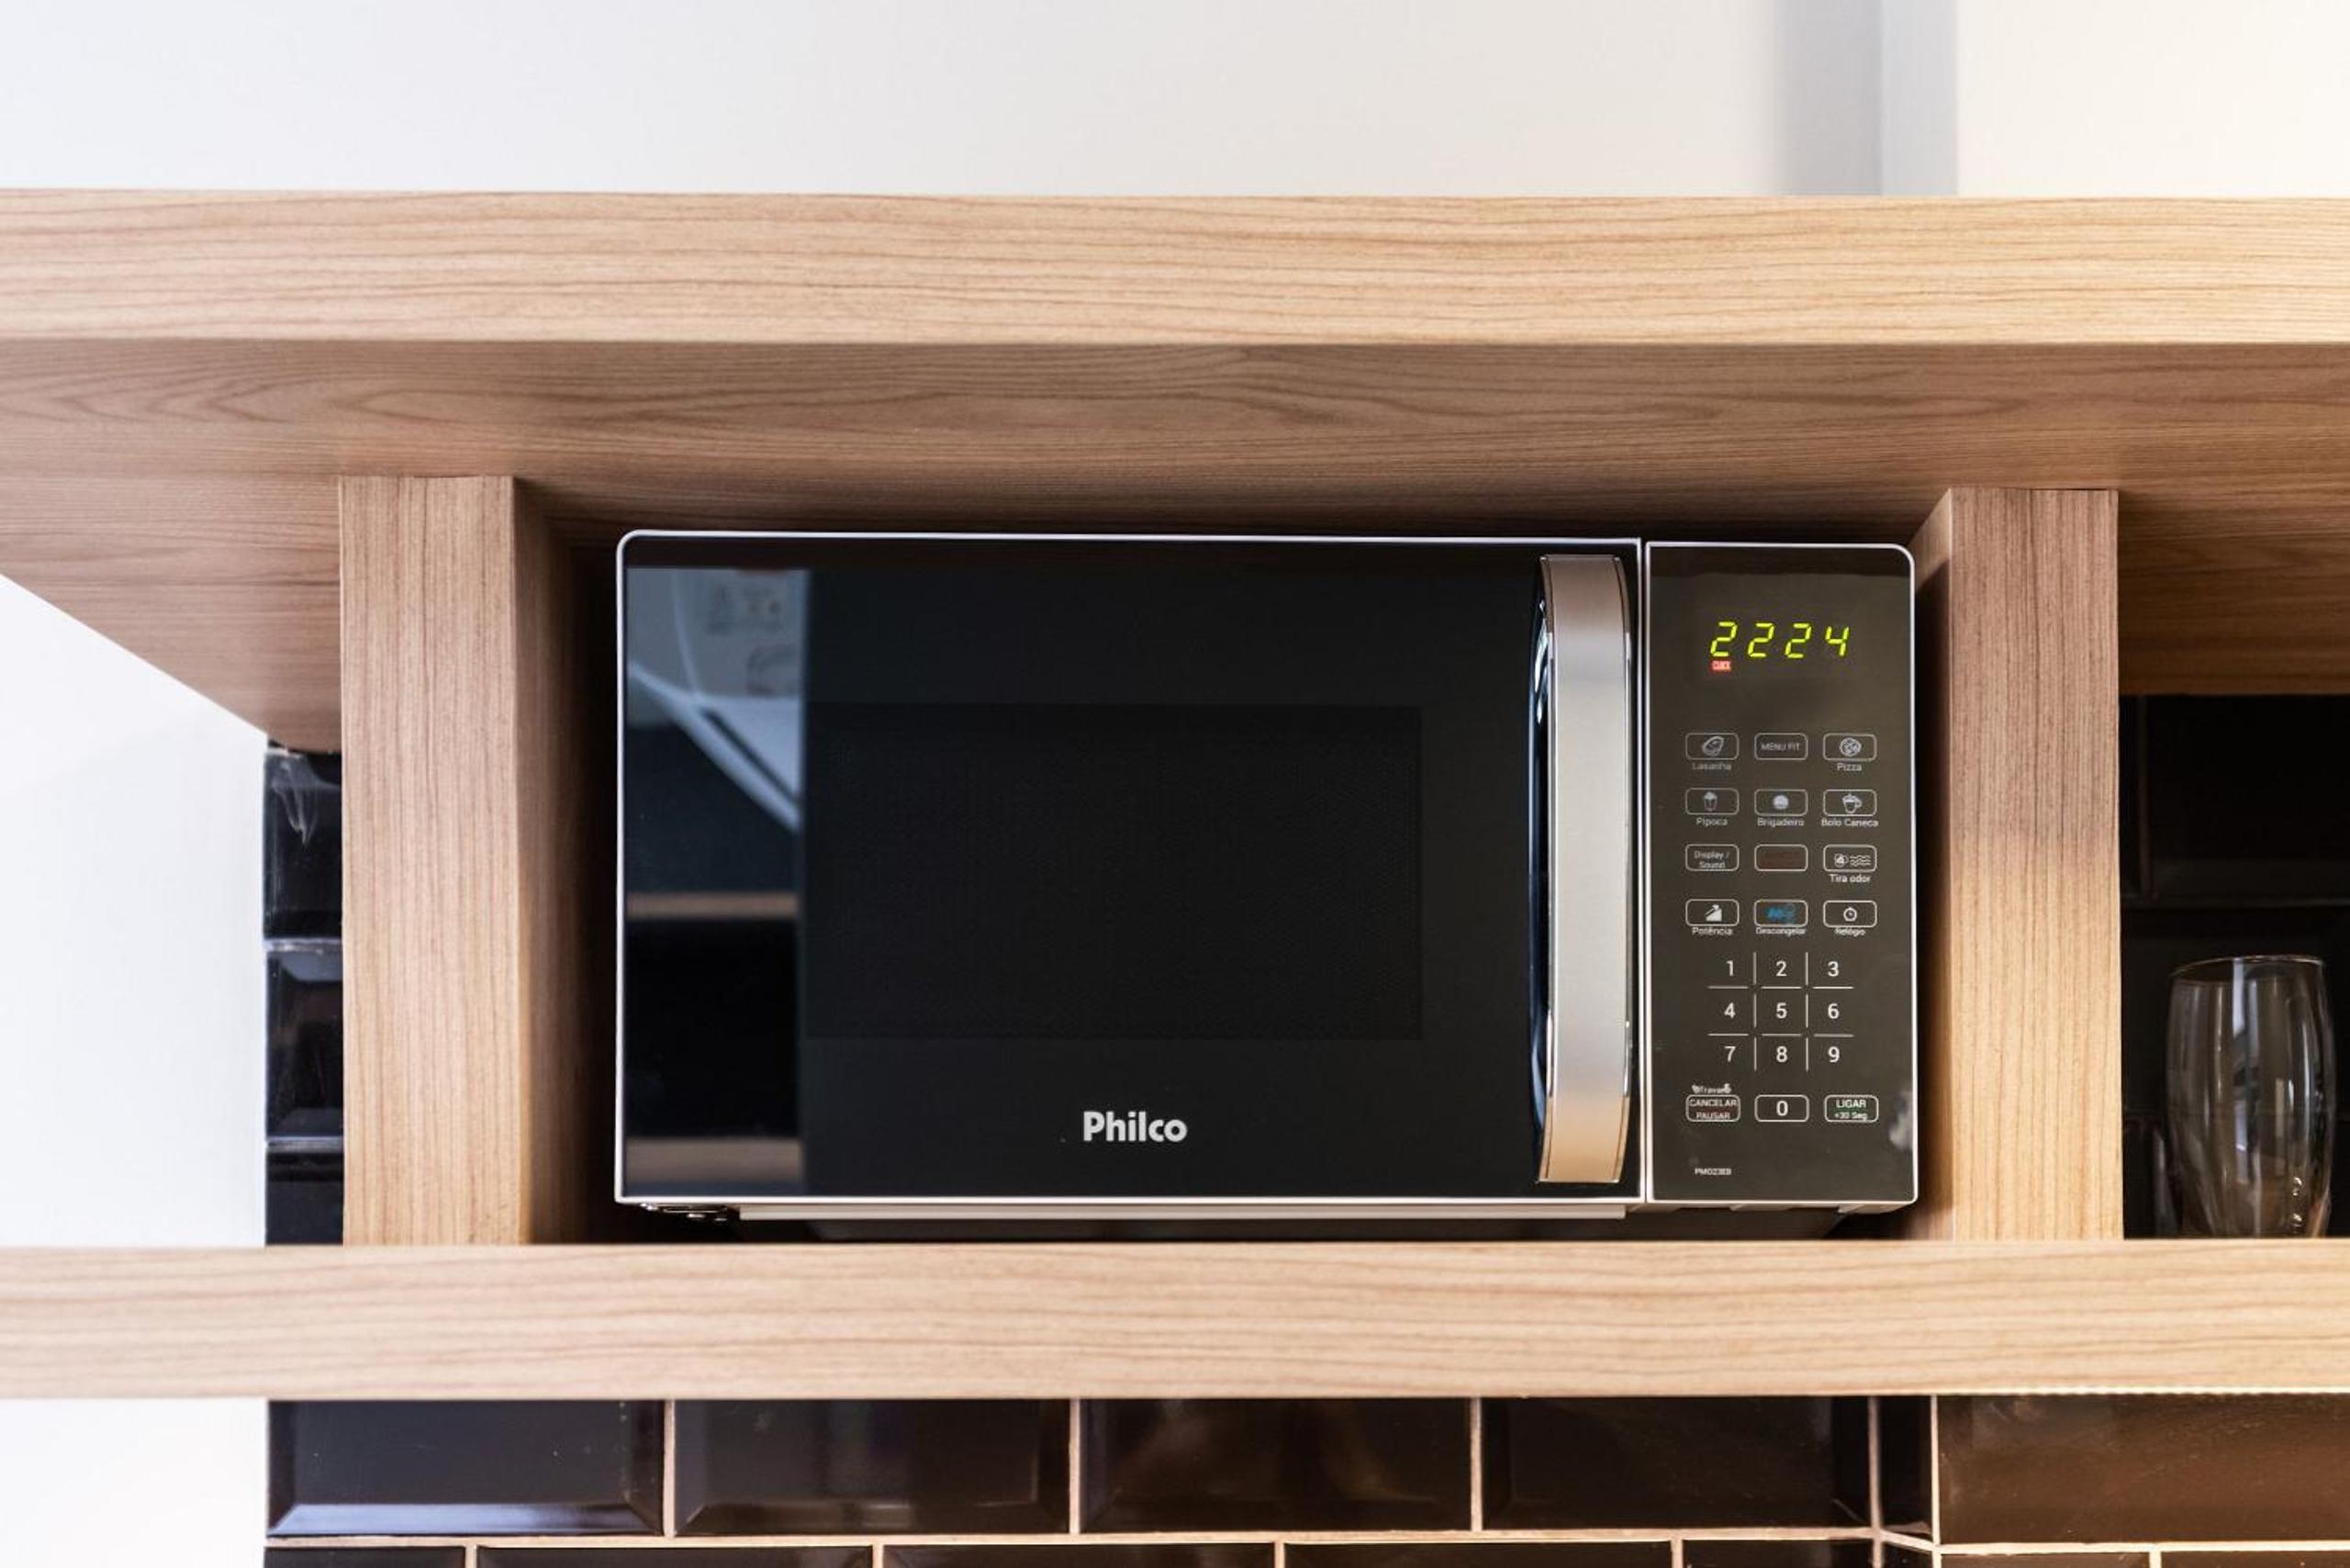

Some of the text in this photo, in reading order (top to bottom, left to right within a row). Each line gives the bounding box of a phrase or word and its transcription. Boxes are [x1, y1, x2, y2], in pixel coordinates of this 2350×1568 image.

[1709, 621, 1850, 659] 2224
[1761, 743, 1801, 751] MENU FIT
[1692, 763, 1732, 771] Lasanha
[1837, 763, 1862, 772] Pizza
[1695, 818, 1728, 827] Pipoca
[1757, 818, 1805, 827] Brigadeiro
[1821, 818, 1878, 827] Bolo Caneca
[1694, 850, 1724, 860] Display
[1830, 874, 1871, 883] Tira odor
[1692, 925, 1733, 935] Potência
[1755, 927, 1807, 937] Descongelar
[1726, 960, 1734, 977] 1
[1775, 961, 1787, 977] 2
[1828, 961, 1839, 977] 3
[1724, 1002, 1736, 1018] 4
[1776, 1002, 1787, 1019] 5
[1828, 1002, 1840, 1019] 6
[1724, 1047, 1736, 1062] 7
[1775, 1047, 1788, 1063] 8
[1828, 1047, 1840, 1063] 9
[1689, 1098, 1737, 1107] CANCELAR
[1836, 1099, 1866, 1108] LIGAR
[1775, 1101, 1788, 1116] 0
[1696, 1111, 1730, 1119] PAUSAR
[1083, 1111, 1188, 1142] Philco
